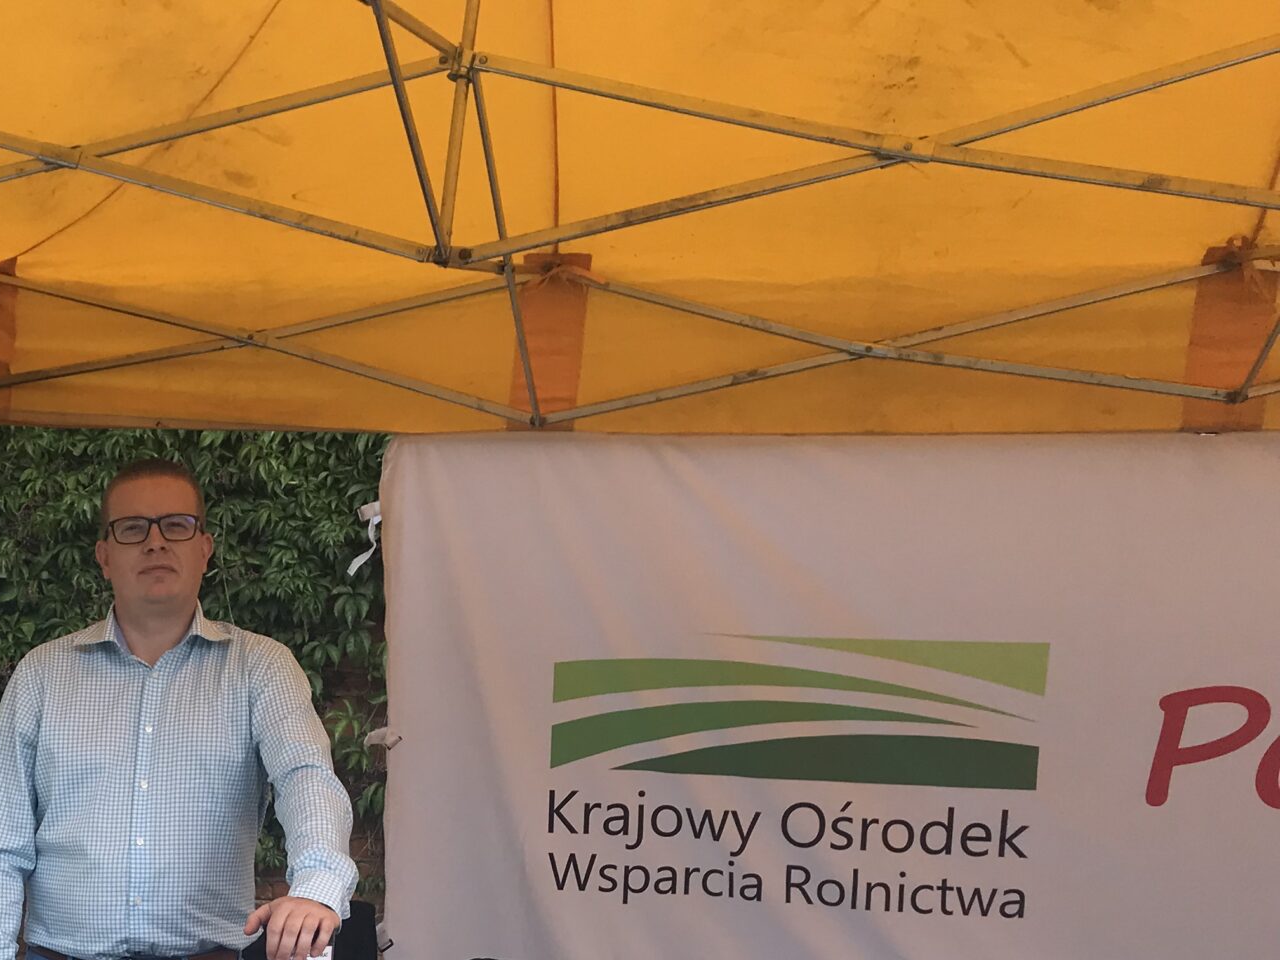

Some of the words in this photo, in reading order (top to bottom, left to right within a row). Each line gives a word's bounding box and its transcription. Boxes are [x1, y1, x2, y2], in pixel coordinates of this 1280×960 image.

[1145, 685, 1280, 809] P
[546, 788, 762, 855] Krajowy
[780, 800, 1031, 859] Ośrodek
[547, 851, 764, 905] Wsparcia
[784, 865, 1028, 919] Rolnictwa
